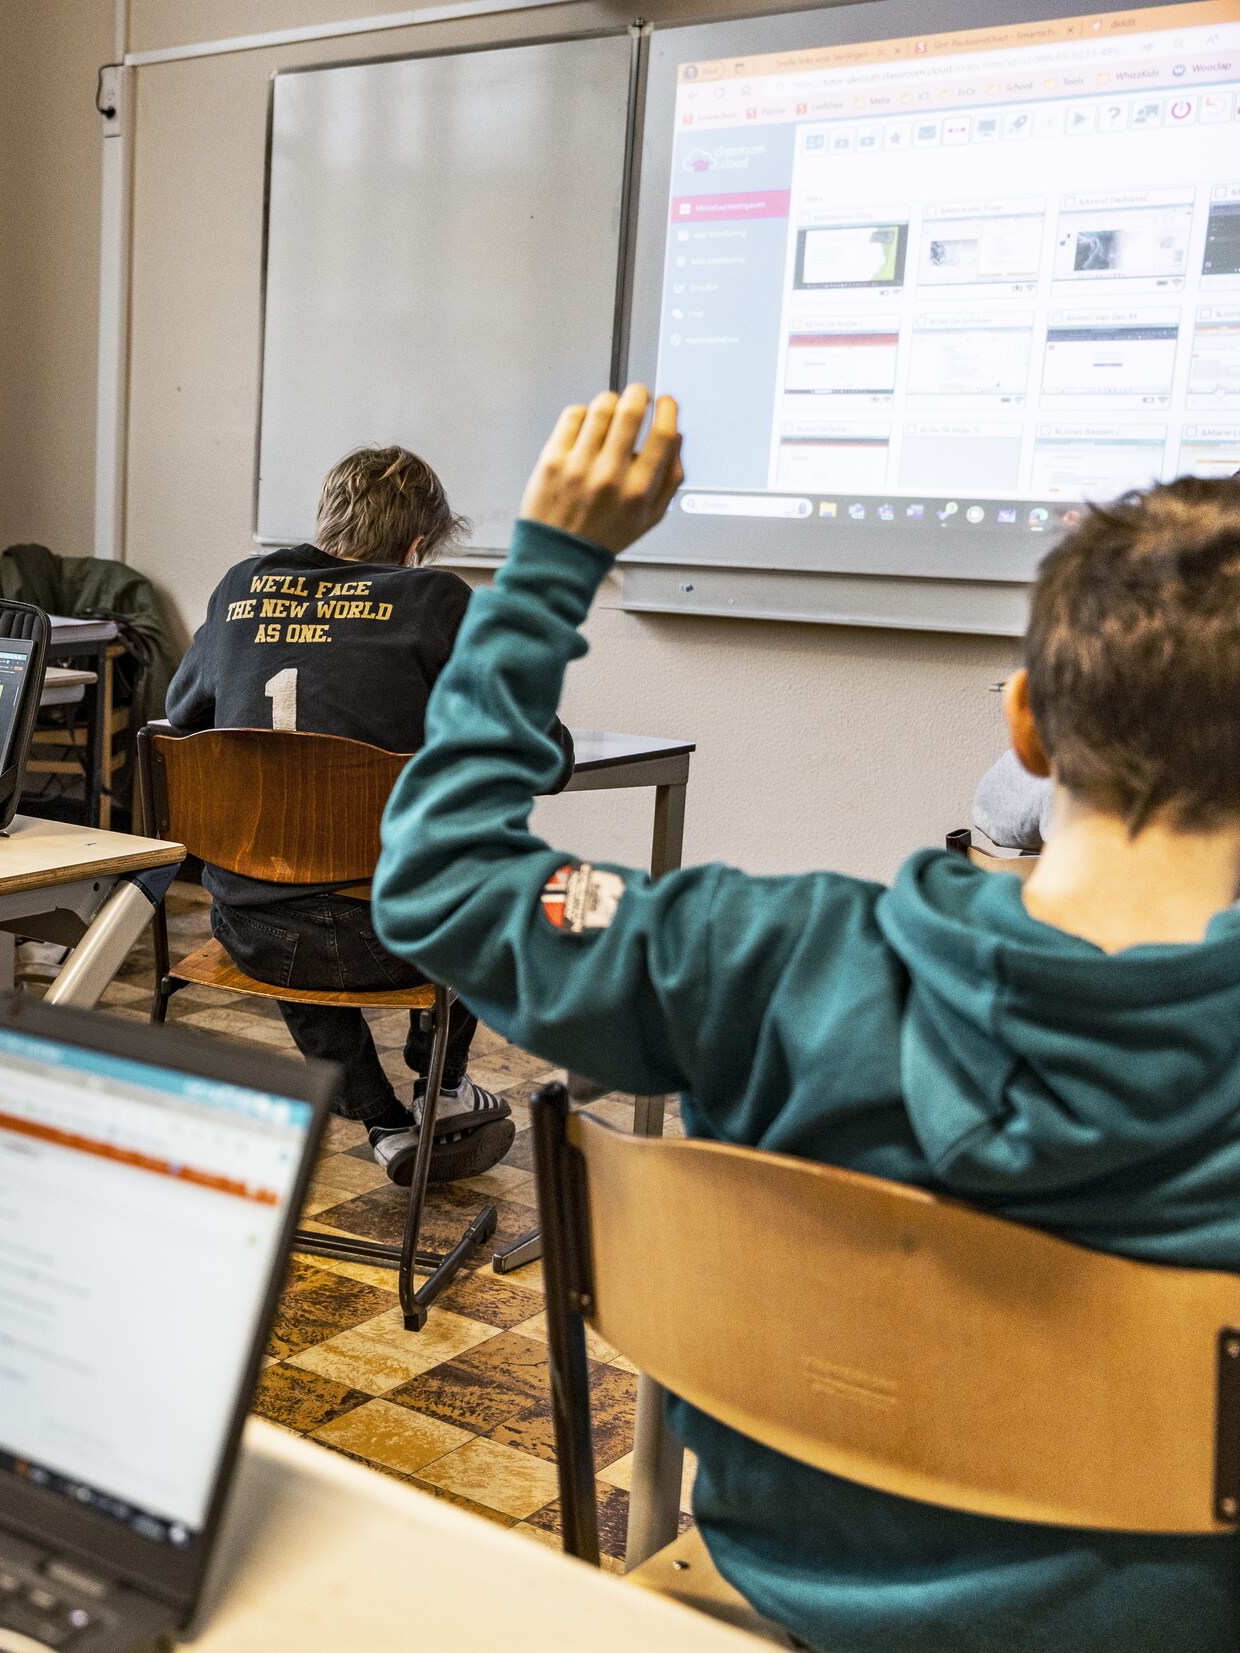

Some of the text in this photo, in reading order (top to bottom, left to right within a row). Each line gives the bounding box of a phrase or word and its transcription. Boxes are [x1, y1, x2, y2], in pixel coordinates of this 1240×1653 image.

[1115, 69, 1159, 81] WhizzKids
[1192, 61, 1232, 73] Wooclap
[1005, 81, 1033, 92] School
[1063, 77, 1084, 86] Tools
[249, 575, 372, 599] WE'LL FACE
[225, 598, 394, 623] THE NEW WORLD
[254, 623, 333, 644] AS ONE.
[264, 668, 299, 732] 1
